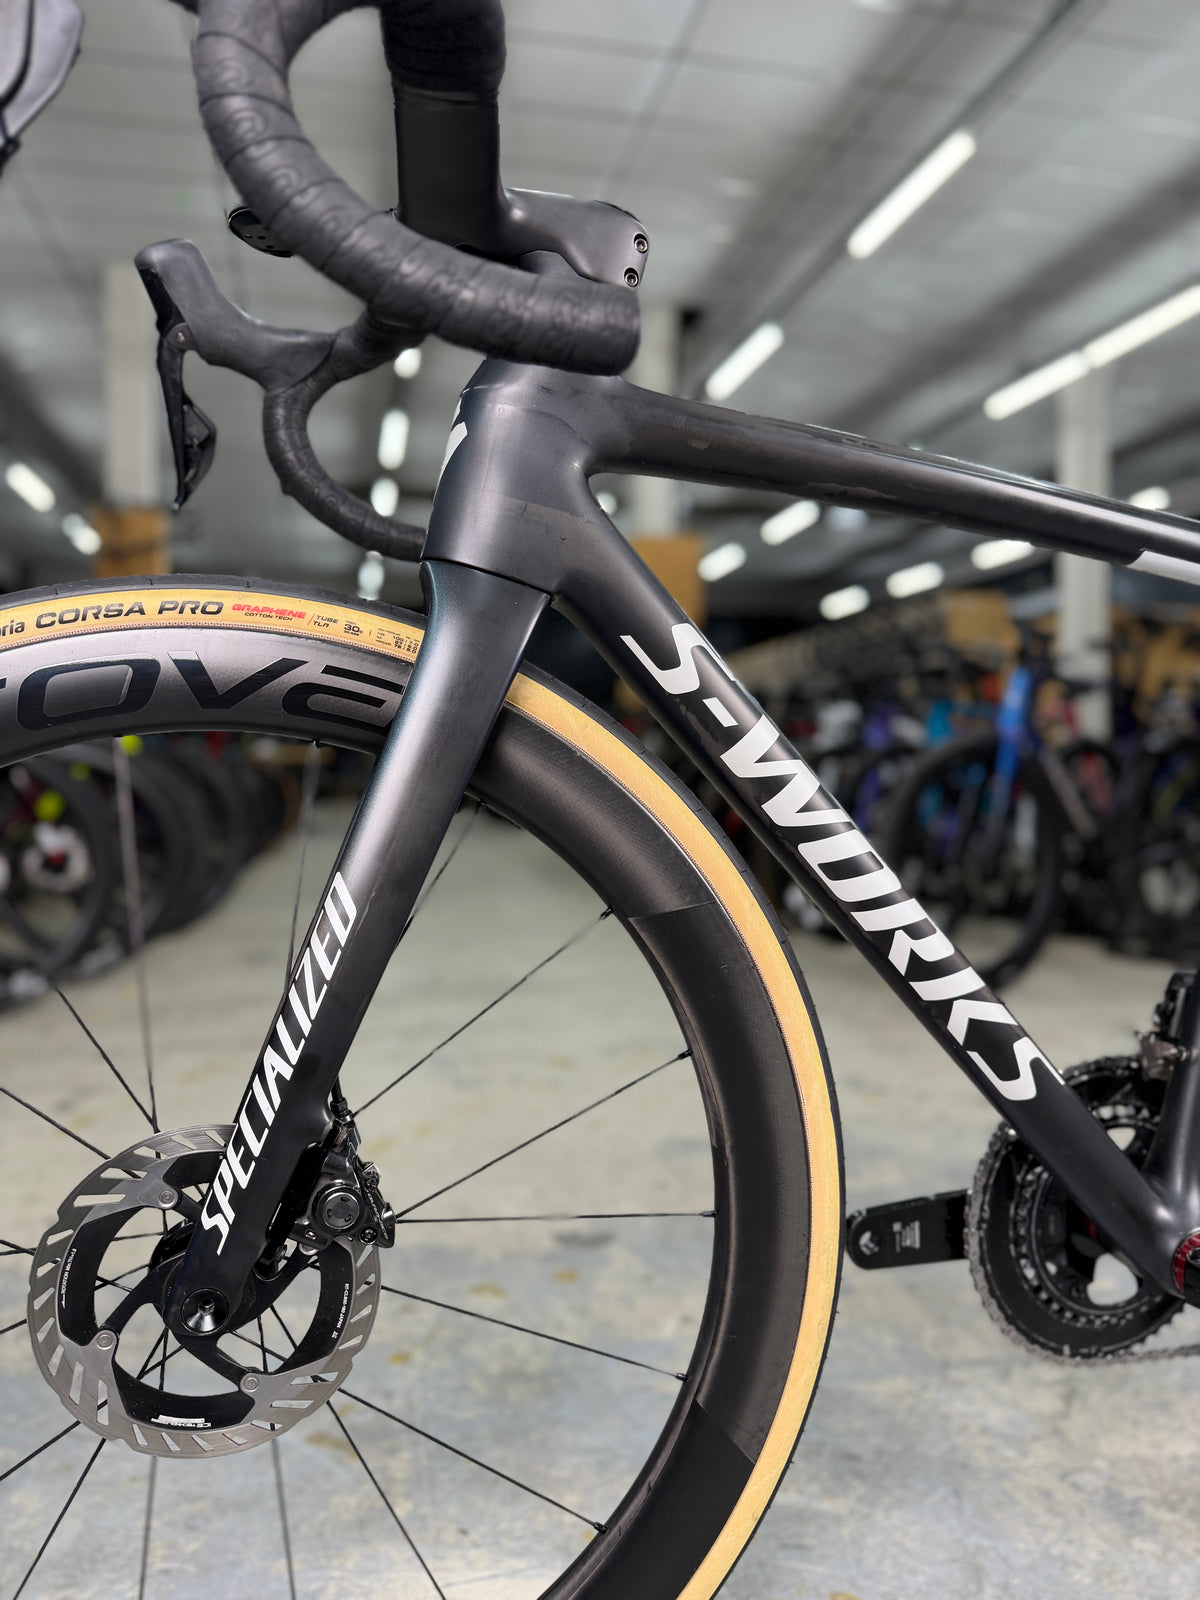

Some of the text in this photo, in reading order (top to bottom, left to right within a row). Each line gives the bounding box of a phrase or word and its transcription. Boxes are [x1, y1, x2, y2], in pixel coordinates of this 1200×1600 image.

[0, 601, 224, 637] ria CORSA PRO
[232, 604, 307, 619] GRAPHENE
[244, 612, 293, 621] COTTON-TECH
[316, 614, 339, 624] TUBE
[620, 623, 1066, 1101] S-WORKS
[200, 871, 357, 1256] SPECIALIZED
